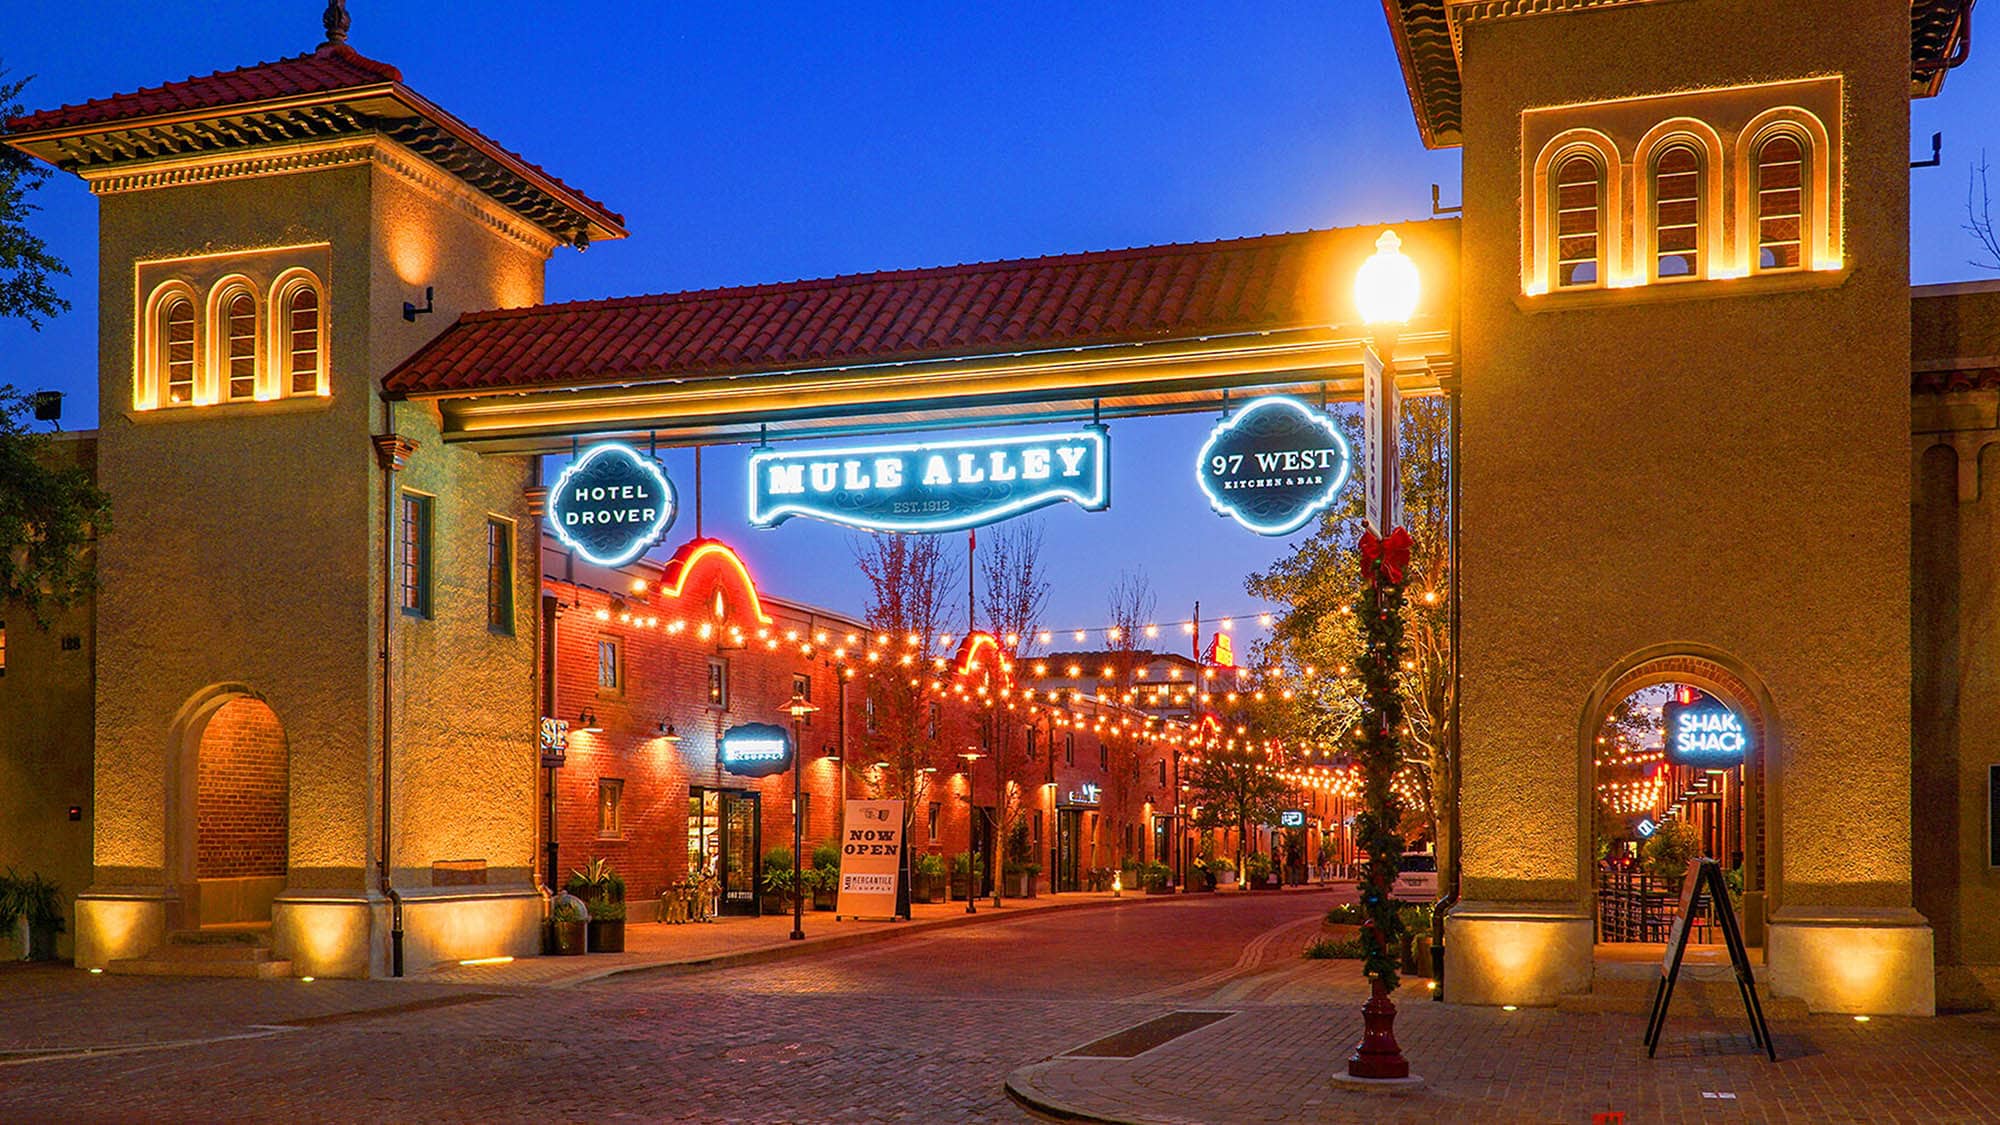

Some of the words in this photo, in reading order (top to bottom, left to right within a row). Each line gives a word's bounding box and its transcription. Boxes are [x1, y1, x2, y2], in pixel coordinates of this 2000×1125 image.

[1212, 455, 1243, 475] 97
[1255, 449, 1334, 473] WEST
[768, 460, 901, 494] MULE
[922, 447, 1087, 485] ALLEY
[1224, 478, 1281, 489] KITCHEN
[1285, 478, 1294, 486] &
[1297, 476, 1323, 485] BAR
[575, 485, 648, 501] HOTEL
[893, 502, 920, 513] EST.
[566, 508, 656, 525] DROVER
[850, 830, 895, 841] NOW
[844, 844, 898, 855] OPEN
